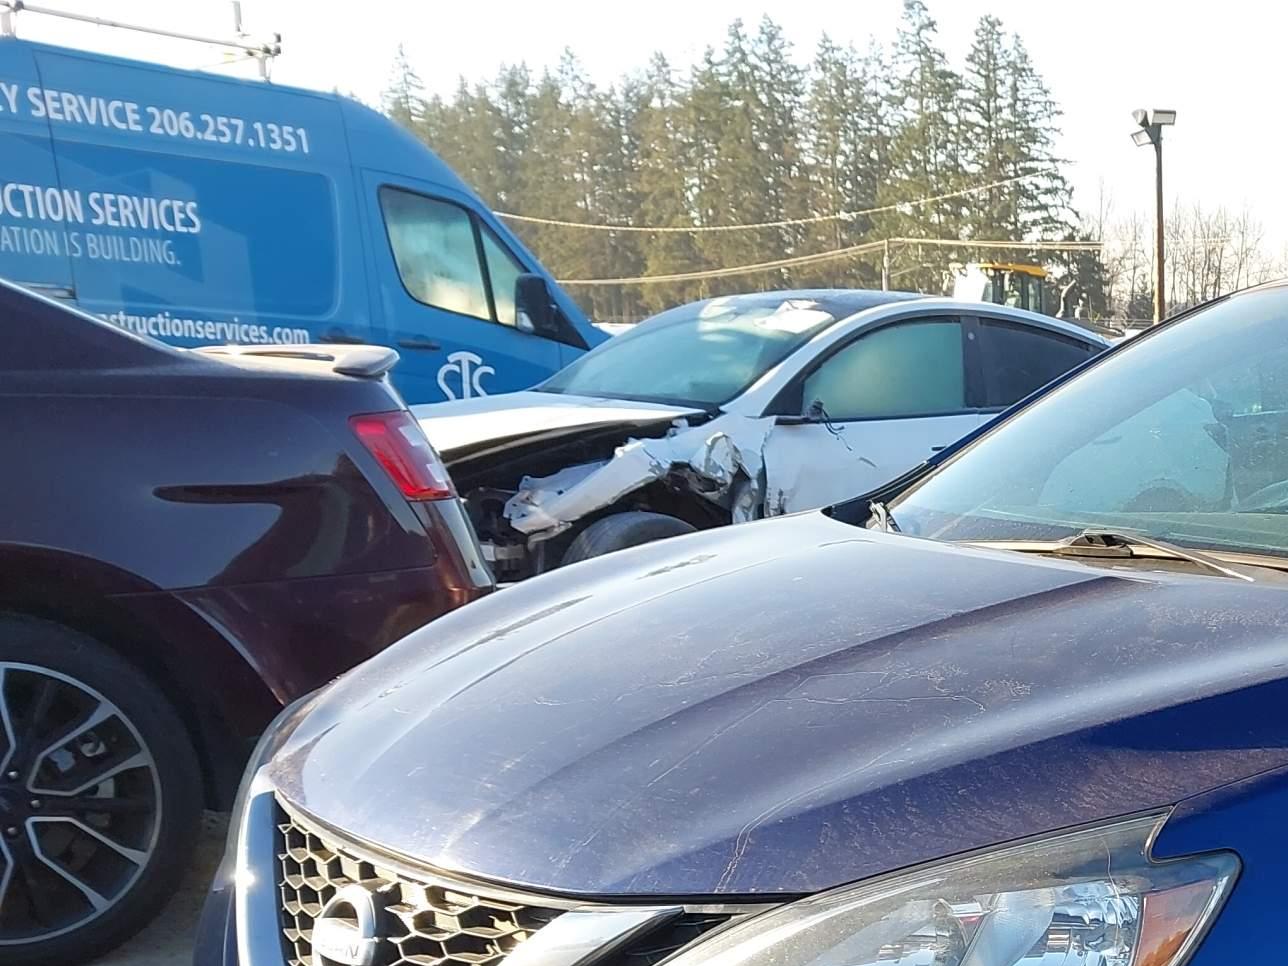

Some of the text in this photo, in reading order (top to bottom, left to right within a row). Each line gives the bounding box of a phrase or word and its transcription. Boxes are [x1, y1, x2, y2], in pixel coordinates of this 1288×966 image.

[27, 87, 143, 132] SERVICE
[146, 106, 309, 154] 206.257.1351
[0, 183, 201, 234] CTION SERVICES
[63, 231, 82, 258] IS
[85, 233, 182, 265] BUILDING.
